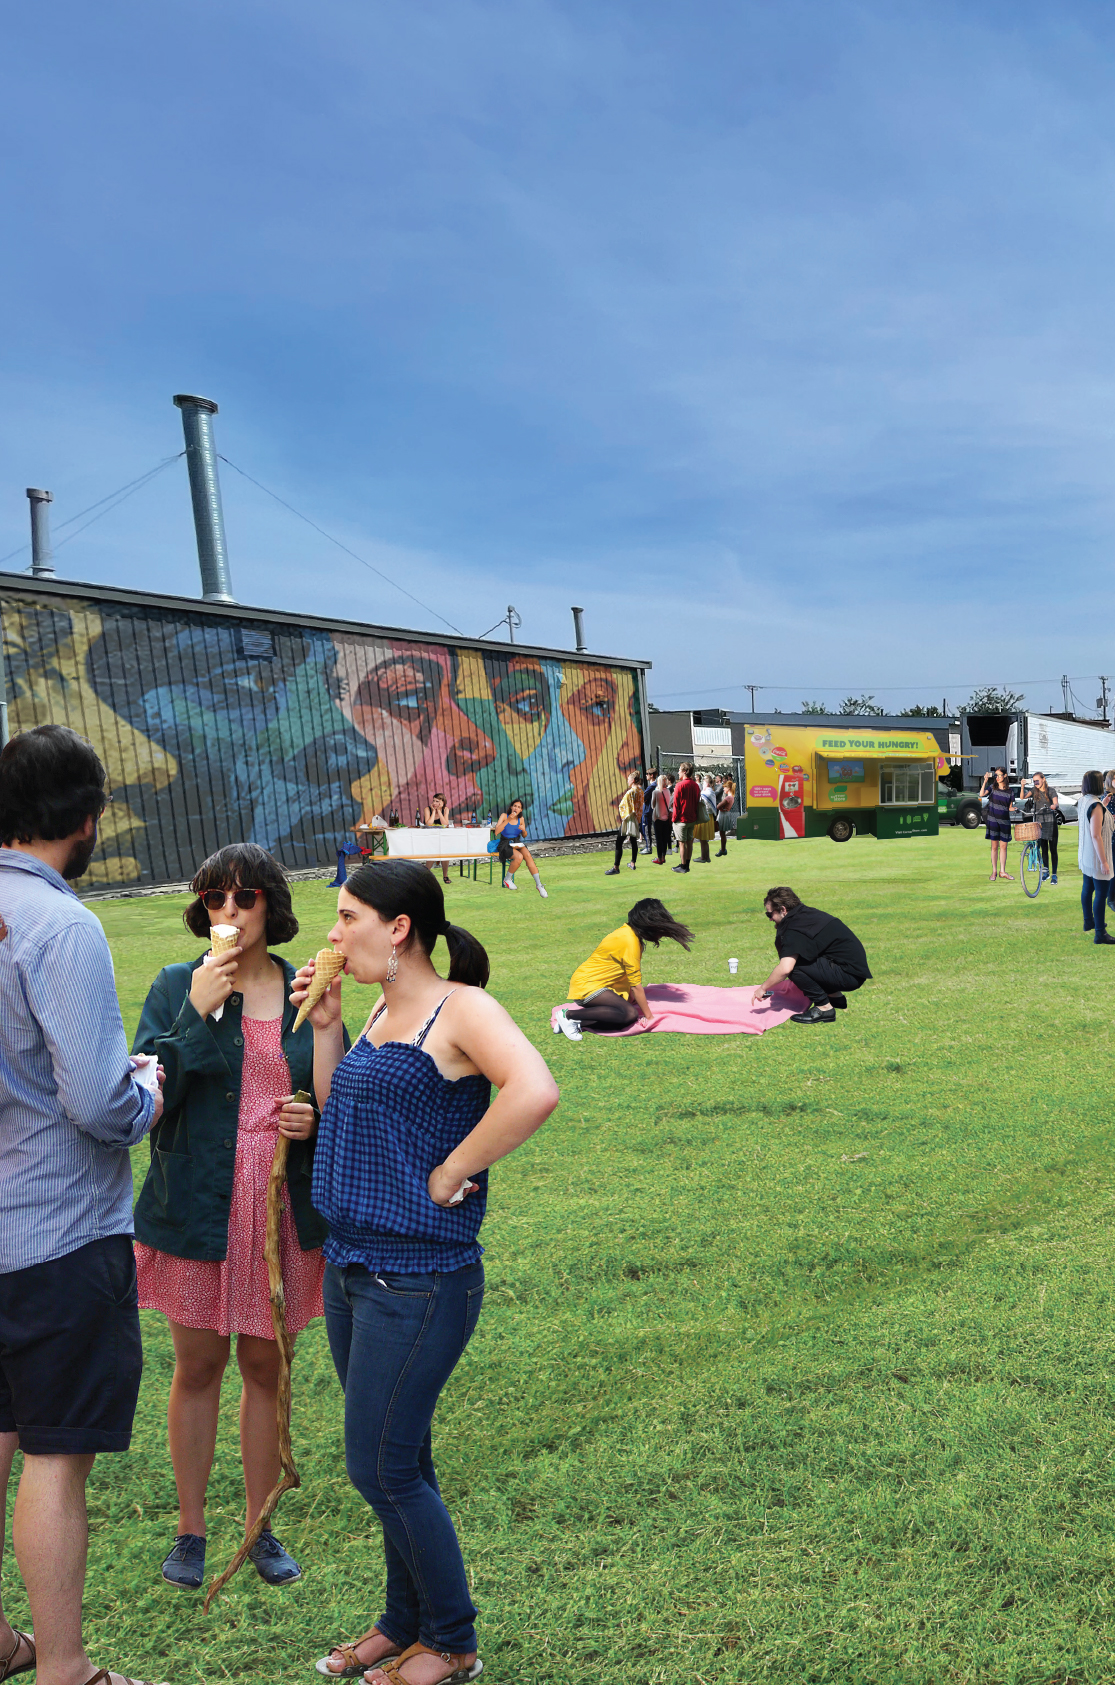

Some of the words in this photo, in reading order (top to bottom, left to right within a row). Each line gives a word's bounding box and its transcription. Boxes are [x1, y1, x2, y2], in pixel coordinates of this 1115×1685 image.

[822, 739, 846, 748] FEED
[848, 739, 875, 749] YOUR
[877, 740, 919, 749] HUNGRY!
